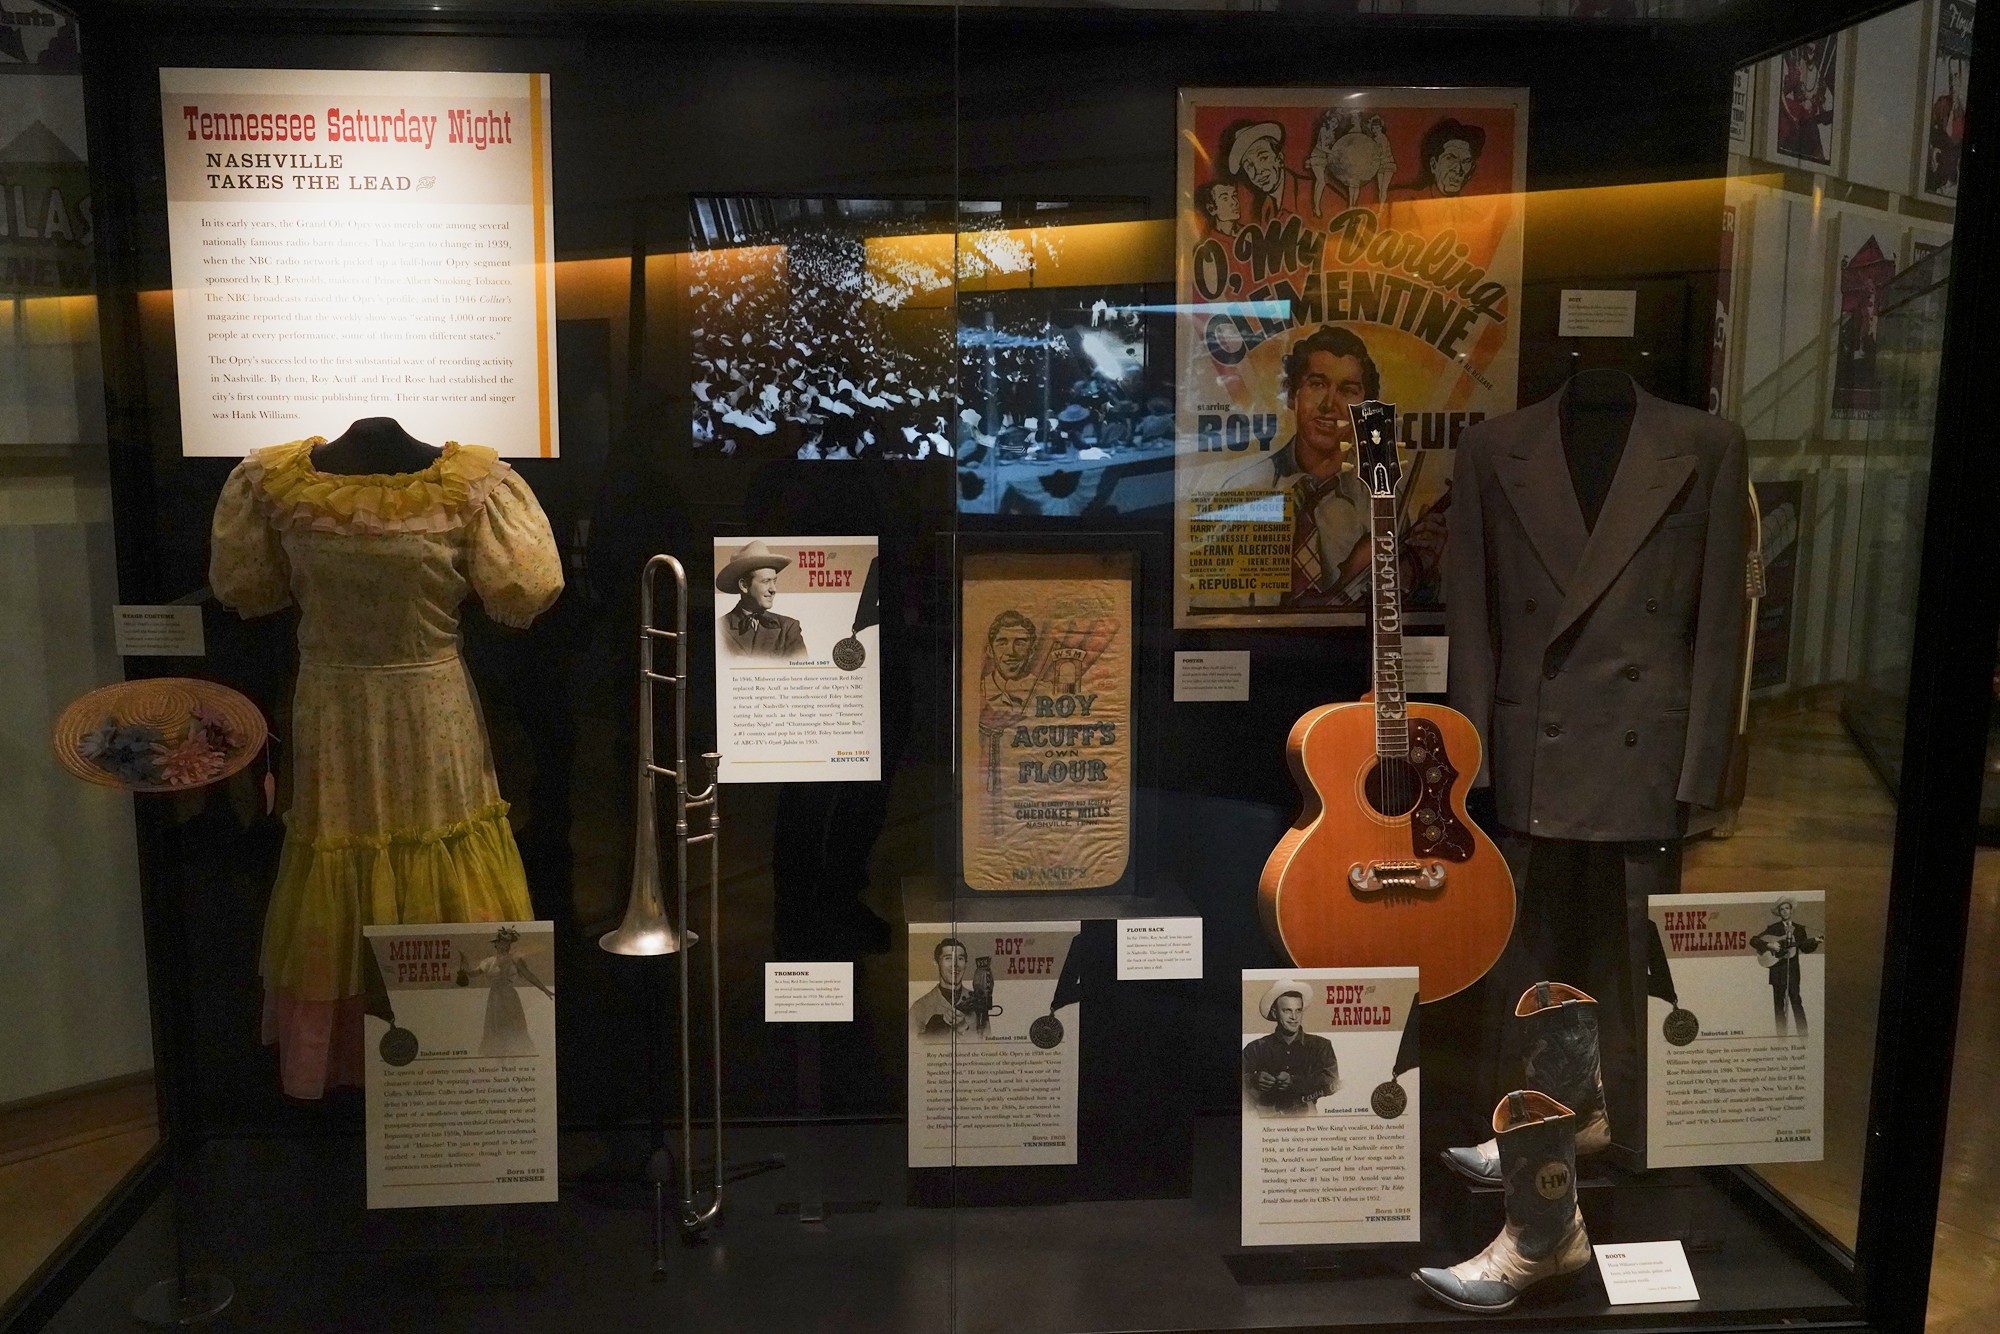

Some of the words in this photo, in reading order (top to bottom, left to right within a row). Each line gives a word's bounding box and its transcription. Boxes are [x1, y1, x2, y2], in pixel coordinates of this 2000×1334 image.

[184, 106, 315, 141] Tennessee
[327, 108, 437, 149] Saturday
[448, 109, 511, 150] Night
[206, 153, 343, 169] NASHVILLE
[208, 175, 284, 190] TAKES
[293, 176, 340, 191] THE
[350, 176, 411, 191] LEAD
[226, 219, 248, 230] early
[251, 220, 277, 230] years,
[446, 223, 476, 232] among
[479, 221, 510, 231] several
[203, 238, 247, 249] nationally
[250, 238, 283, 248] famous
[286, 239, 310, 248] radio
[440, 240, 471, 251] change
[488, 240, 511, 249] 1939,
[203, 257, 228, 265] when
[250, 256, 273, 266] NBC
[446, 258, 471, 269] Opry
[474, 260, 511, 270] segment
[205, 275, 249, 286] sponsored
[433, 276, 472, 288] Smoking
[474, 277, 512, 287] Tobacco.
[227, 293, 250, 303] NBC
[454, 295, 477, 304] 1946
[207, 312, 250, 323] magazine
[253, 313, 291, 324] reported
[1205, 269, 1479, 366] CLEMENTINE
[208, 331, 238, 342] people
[252, 334, 275, 342] every
[429, 332, 467, 341] different
[228, 355, 259, 367] Opry's
[439, 356, 480, 368] recording
[482, 357, 514, 369] activity
[223, 373, 267, 384] Nashville.
[285, 374, 308, 385] then,
[311, 374, 328, 386] Roy
[429, 375, 446, 384] had
[449, 375, 497, 385] established
[499, 375, 514, 384] the
[212, 392, 234, 403] city's
[237, 392, 254, 402] first
[256, 394, 291, 404] country
[293, 393, 319, 402] music
[423, 394, 439, 402] star
[441, 394, 467, 403] writer
[470, 394, 487, 403] and
[490, 393, 516, 405] singer
[1198, 403, 1230, 411] starring
[232, 410, 257, 420] Hank
[259, 410, 301, 421] Williams.
[1198, 414, 1277, 452] ROY
[1197, 504, 1213, 512] THE
[1218, 504, 1245, 512] RADIO
[1191, 524, 1217, 533] HARRY
[1253, 524, 1291, 532] CHESHIRE
[1204, 545, 1234, 556] FRANK
[1238, 544, 1291, 556] ALBERTSON
[799, 551, 825, 568] RED
[1190, 558, 1213, 567] LORNA
[1217, 558, 1234, 566] GRAY
[1248, 558, 1269, 566] IRENE
[1273, 558, 1290, 566] RYAN
[809, 570, 852, 587] FOLEY
[1199, 578, 1257, 590] REPUBLIC
[1054, 649, 1082, 659] WSM
[1035, 693, 1098, 718] ROY
[1011, 721, 1116, 748] ACUFF'S
[1045, 750, 1079, 758] OWN
[1018, 759, 1108, 784] FLOUR
[1016, 808, 1072, 820] CHEROKEE
[1078, 807, 1110, 818] MILLS
[1665, 911, 1706, 930] HANK
[995, 938, 1023, 955] ROY
[1670, 931, 1746, 951] WILLIAMS
[390, 940, 450, 960] MINNIE
[399, 962, 450, 983] PEARL
[1008, 957, 1054, 974] ACUFF
[1327, 985, 1364, 1004] EDDY
[1332, 1006, 1391, 1025] ARNOLD
[496, 1175, 545, 1183] TENNESSEE
[1541, 1170, 1568, 1189] HW
